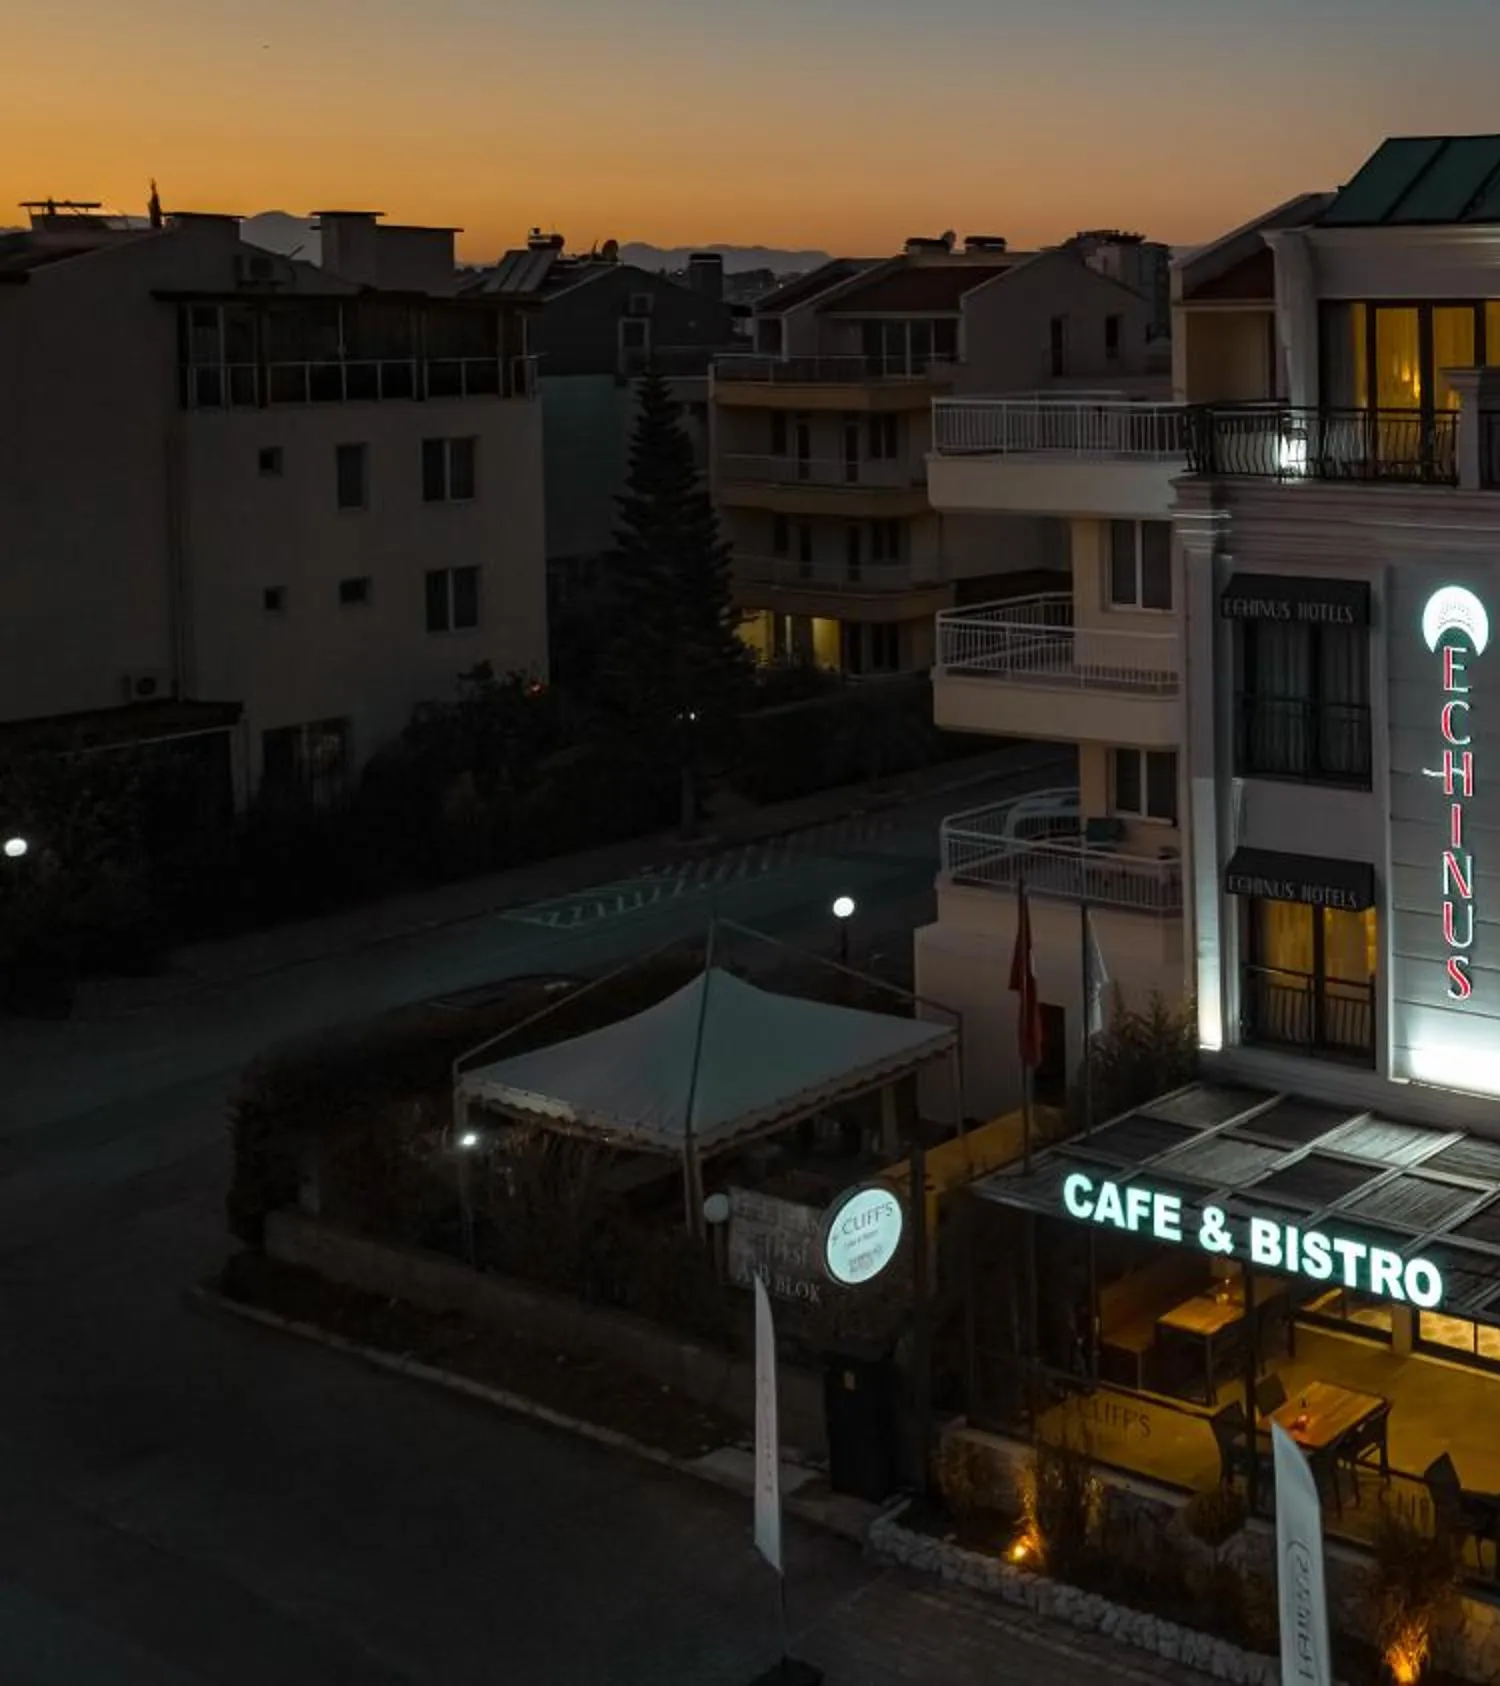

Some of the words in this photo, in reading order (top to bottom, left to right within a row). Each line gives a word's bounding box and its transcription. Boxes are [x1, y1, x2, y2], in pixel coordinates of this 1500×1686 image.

[1298, 601, 1355, 625] HOTELS
[1422, 645, 1474, 999] ECHINUS
[1301, 881, 1358, 909] HOTELS
[1063, 1172, 1183, 1242] CAFE
[1199, 1205, 1234, 1255] &
[1250, 1215, 1443, 1308] BISTRO
